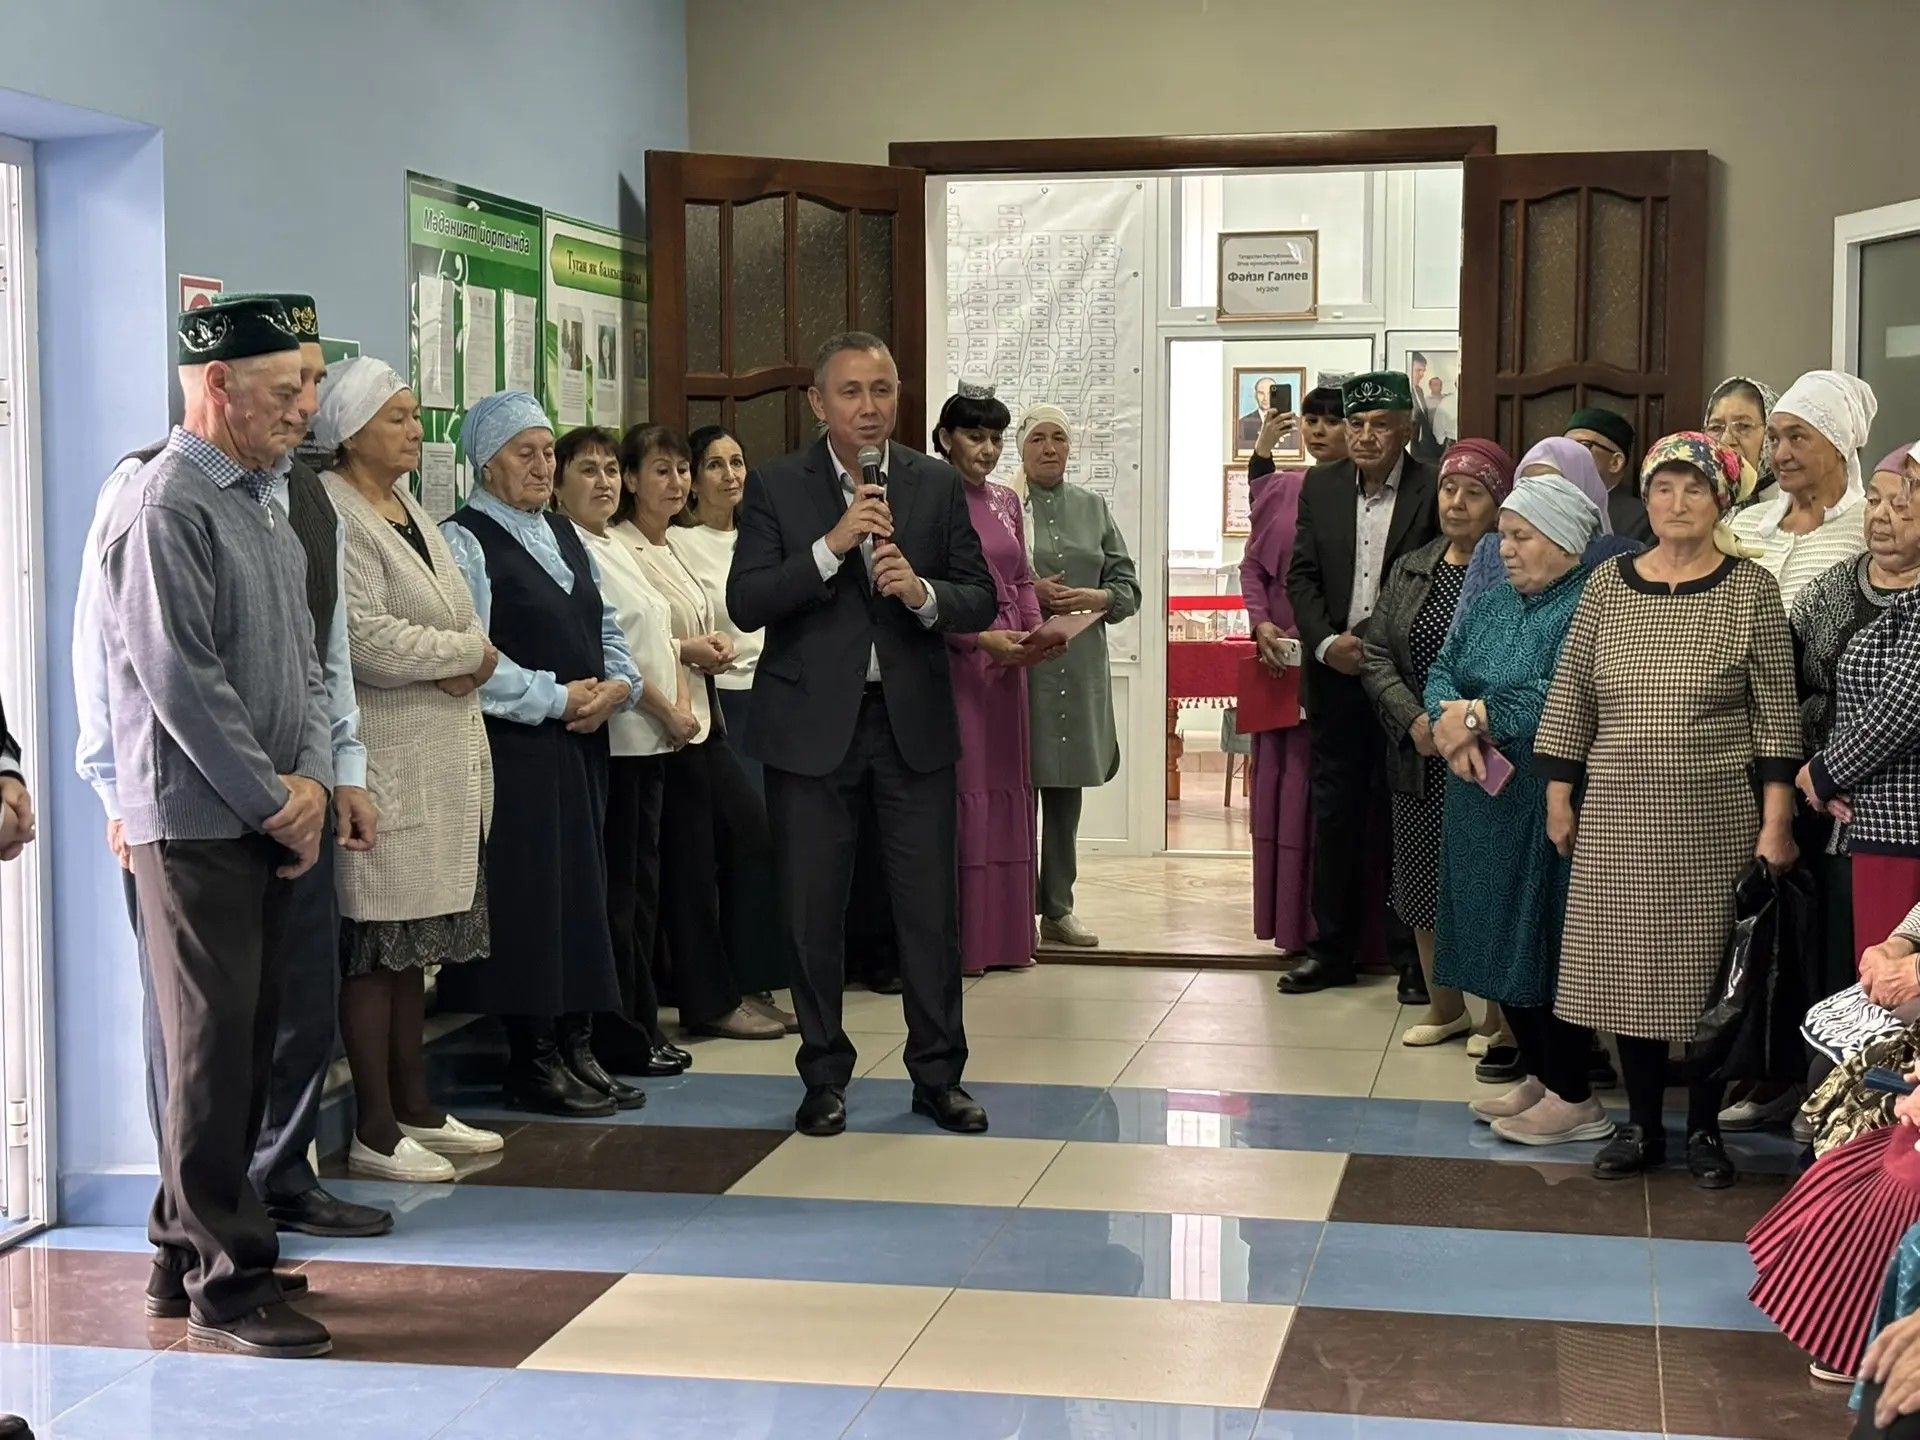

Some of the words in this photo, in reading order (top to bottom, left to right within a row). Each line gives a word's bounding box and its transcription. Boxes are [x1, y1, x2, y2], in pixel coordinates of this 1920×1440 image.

[423, 207, 478, 243] Мәдәният
[479, 220, 530, 256] йортында
[566, 249, 587, 275] Туган
[588, 262, 598, 275] як
[1227, 271, 1265, 282] Фәйзи
[1268, 271, 1309, 281] Галиев
